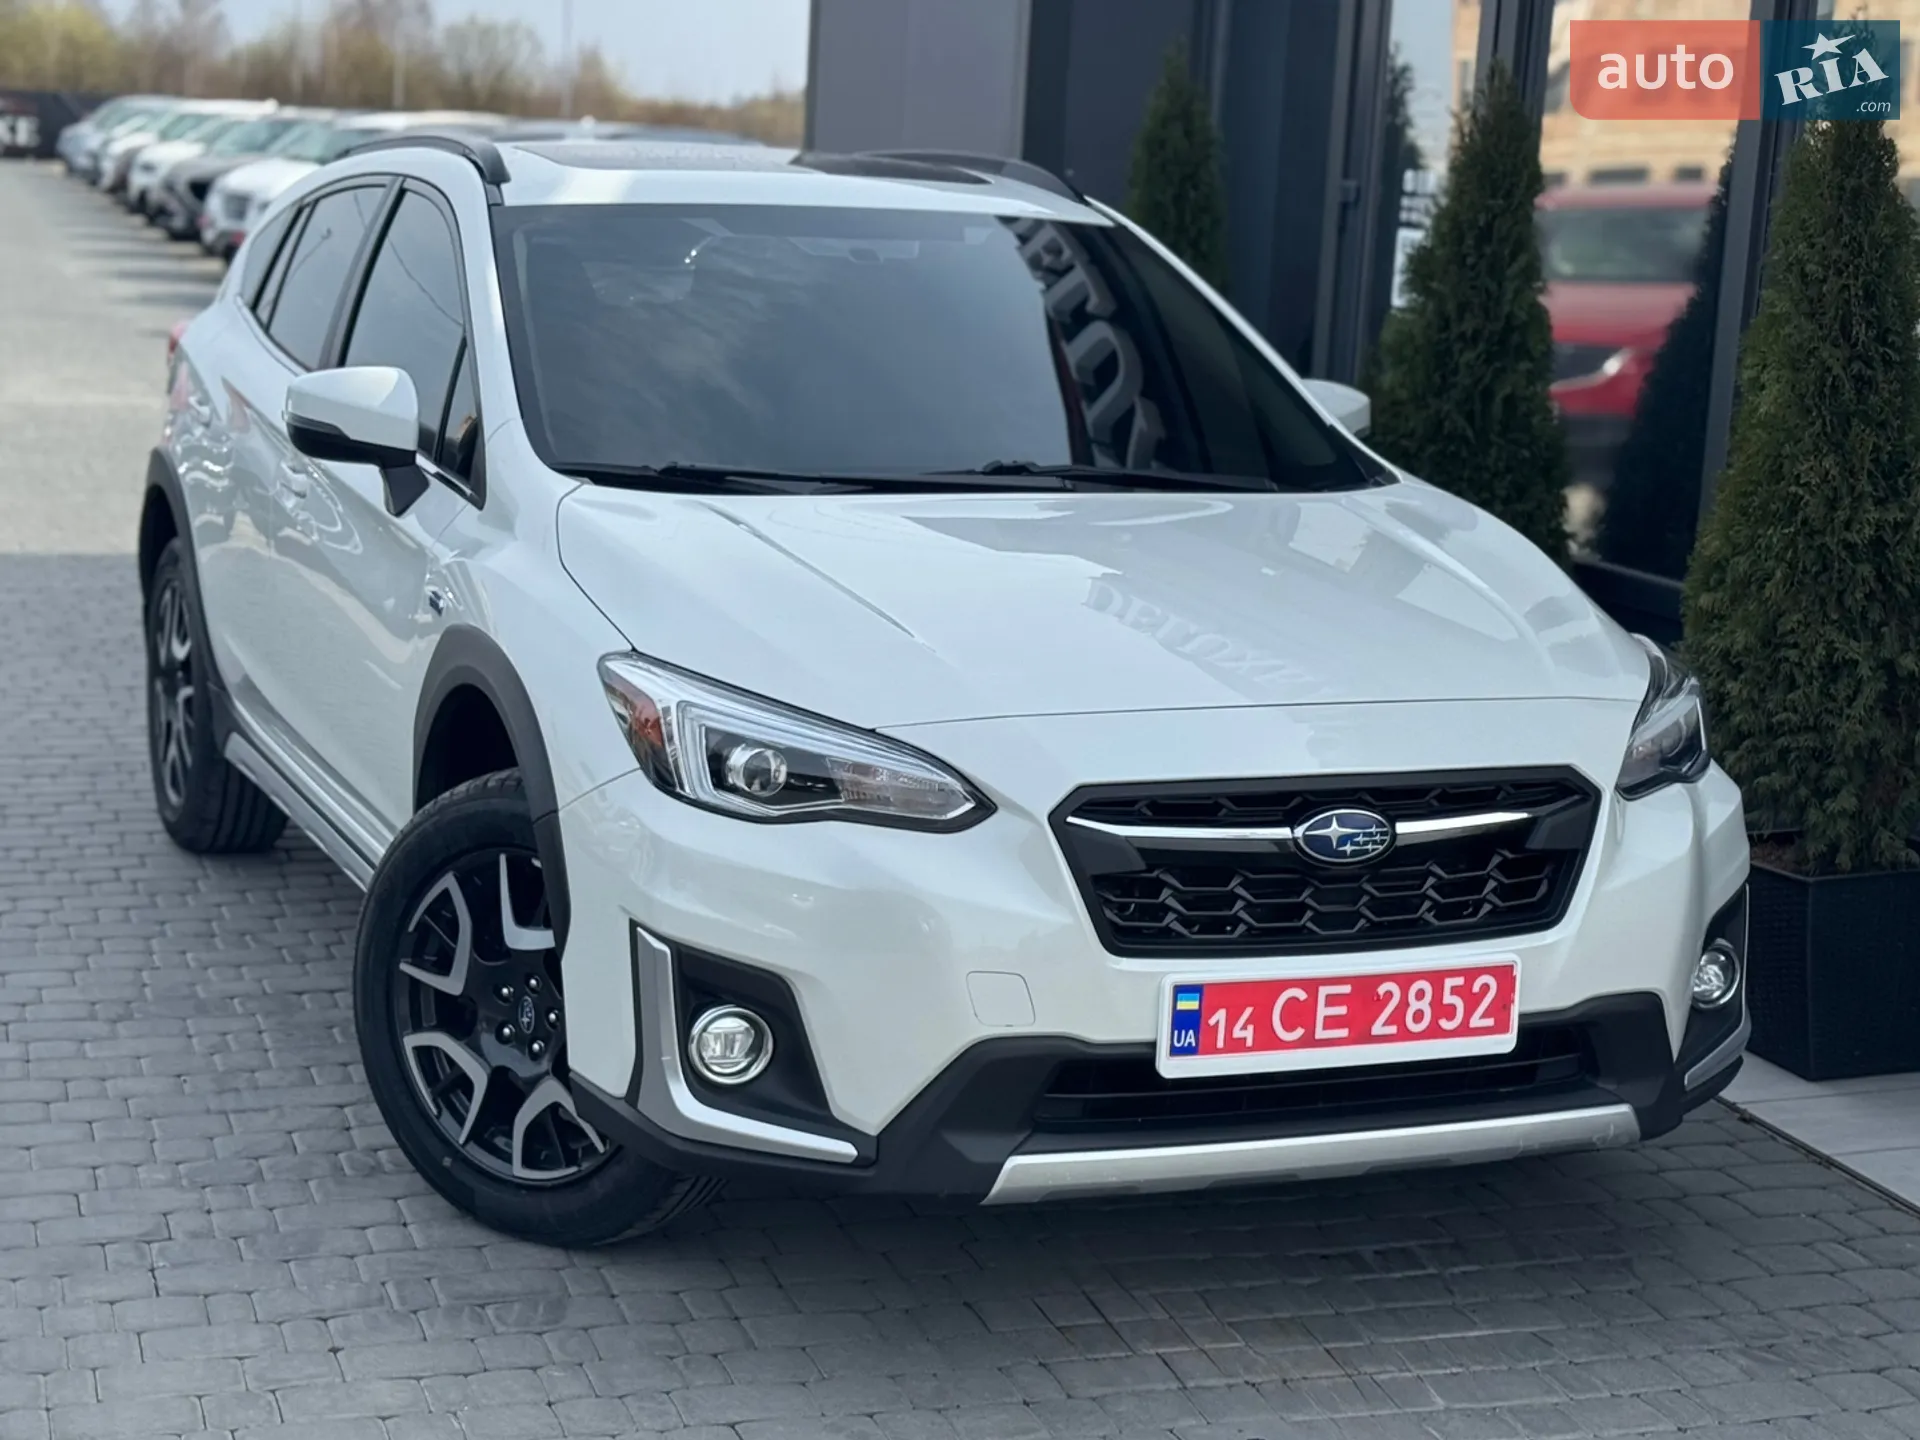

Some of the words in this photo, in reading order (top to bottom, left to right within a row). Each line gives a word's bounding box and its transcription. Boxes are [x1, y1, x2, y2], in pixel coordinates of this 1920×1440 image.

[1207, 1006, 1255, 1049] 14
[1271, 984, 1352, 1042] CE
[1370, 973, 1498, 1037] 2852
[1173, 1029, 1196, 1048] UA
